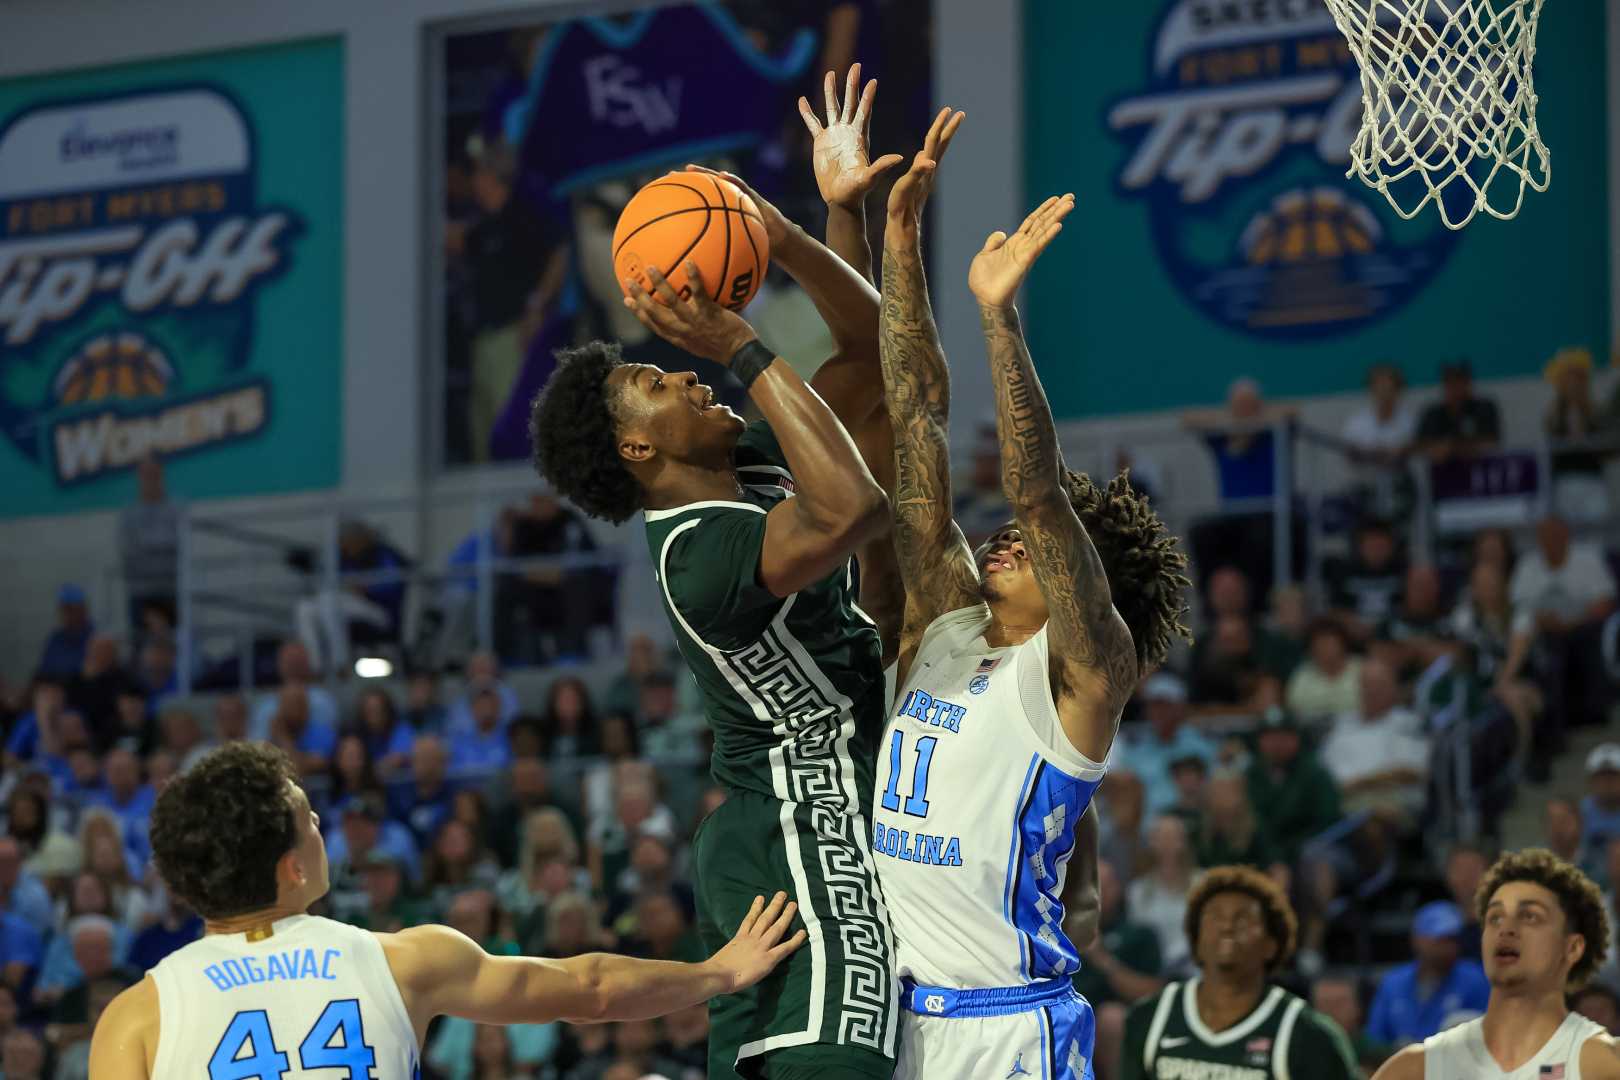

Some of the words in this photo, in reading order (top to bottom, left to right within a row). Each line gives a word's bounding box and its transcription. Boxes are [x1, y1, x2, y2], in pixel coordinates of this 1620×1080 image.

[898, 688, 967, 734] RTH
[881, 728, 938, 818] 11
[873, 821, 963, 867] ROLINA
[203, 947, 341, 992] BOGAVAC
[207, 997, 377, 1080] 44
